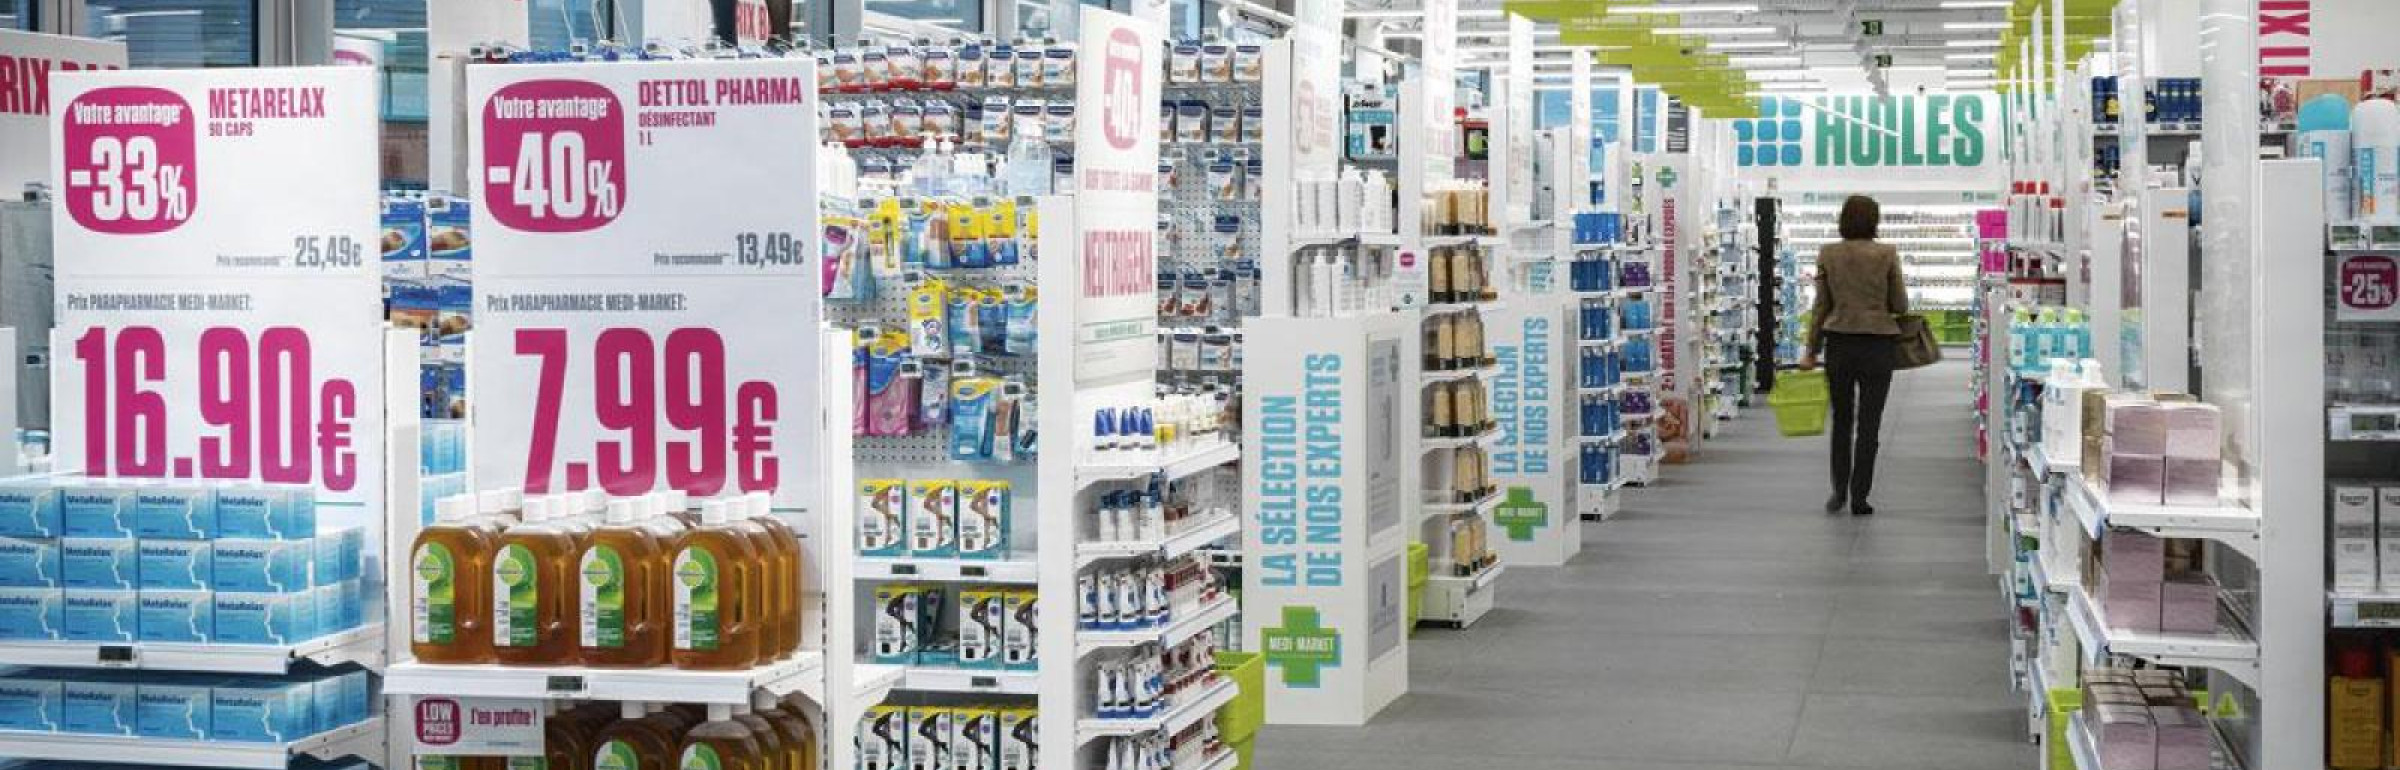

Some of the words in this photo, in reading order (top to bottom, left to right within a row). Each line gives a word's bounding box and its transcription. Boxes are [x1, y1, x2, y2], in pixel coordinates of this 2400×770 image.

[209, 87, 325, 119] METARELAX
[493, 95, 534, 119] Votre
[639, 79, 709, 106] DETTOL
[715, 77, 802, 105] PHARMA
[74, 102, 111, 125] Votre
[209, 123, 223, 136] 90
[225, 123, 253, 136] CAPS
[1816, 94, 1984, 166] HUILES
[70, 136, 186, 221] -33%
[488, 131, 617, 219] -40%
[295, 236, 361, 270] 25,49€
[736, 232, 803, 269] 13,49€
[67, 294, 88, 310] Prix
[90, 294, 175, 310] PARAPHARMACIE
[487, 294, 508, 311] Prix
[511, 294, 603, 311] PARAPHARMACIE
[2343, 274, 2393, 304] -25%
[1524, 317, 1548, 400] EXPERTS
[77, 327, 356, 491] 16.90€
[516, 327, 779, 496] 7.99€
[1306, 354, 1341, 478] EXPERTS
[1524, 406, 1548, 444] NOS
[1257, 397, 1296, 544] SÉLECTION
[1494, 453, 1518, 472] LA
[1524, 450, 1548, 472] DE
[1306, 485, 1341, 543] NOS
[1262, 556, 1296, 586] LA
[1306, 552, 1341, 586] DE
[423, 703, 452, 720] LOW
[493, 707, 531, 727] profite
